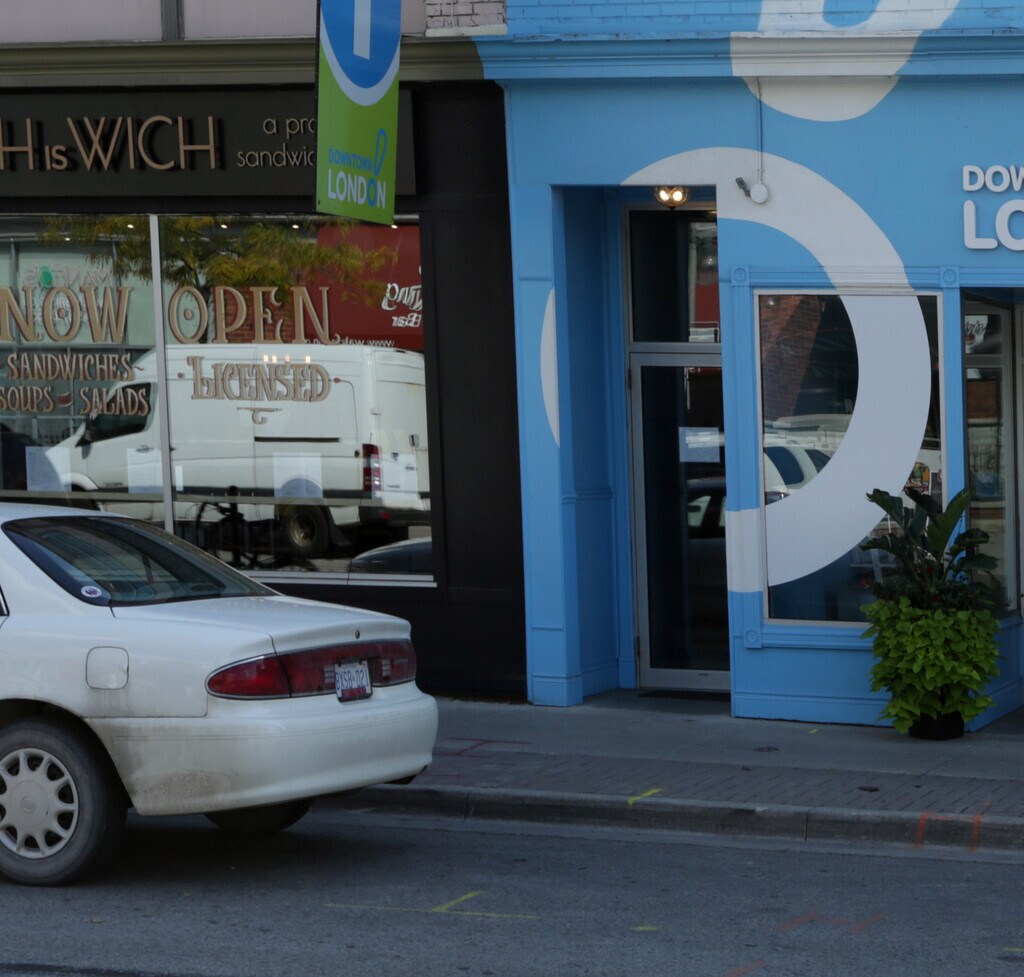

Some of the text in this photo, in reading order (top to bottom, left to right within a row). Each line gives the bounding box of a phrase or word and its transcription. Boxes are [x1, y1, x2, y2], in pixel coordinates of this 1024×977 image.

[263, 118, 277, 134] a
[328, 147, 373, 172] DOWNTOWN
[327, 168, 386, 210] LONDON
[0, 286, 133, 342] NOW
[168, 285, 341, 345] OPEN
[7, 352, 136, 382] SANDWICHES
[0, 386, 55, 413] SOUPS
[79, 387, 151, 416] SALADS
